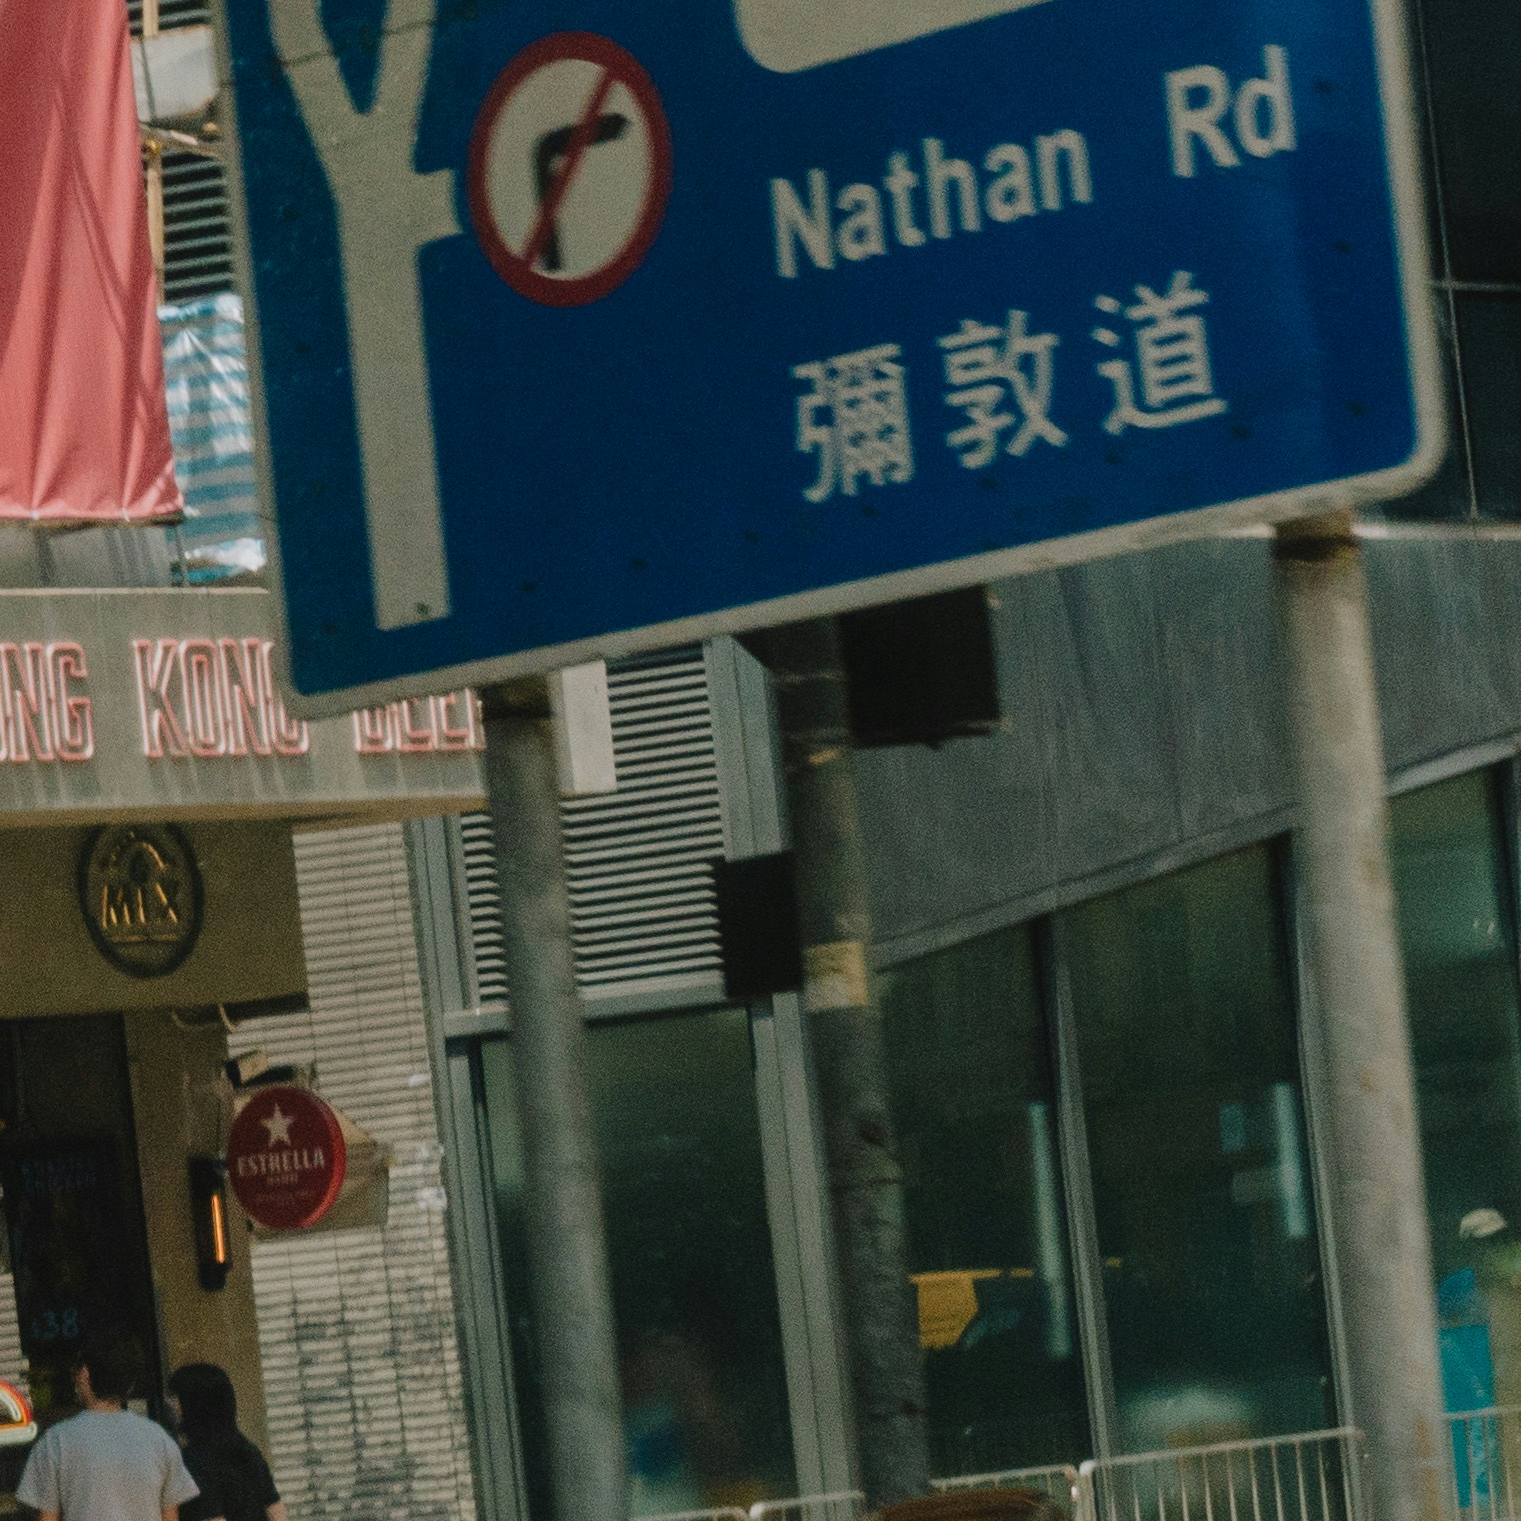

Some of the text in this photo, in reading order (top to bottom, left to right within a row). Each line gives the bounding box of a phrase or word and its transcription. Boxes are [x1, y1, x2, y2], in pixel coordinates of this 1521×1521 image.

[770, 46, 1296, 279] Nathan Rd
[791, 271, 1227, 503] 彌敦道
[237, 1147, 325, 1177] ESTRELLA
